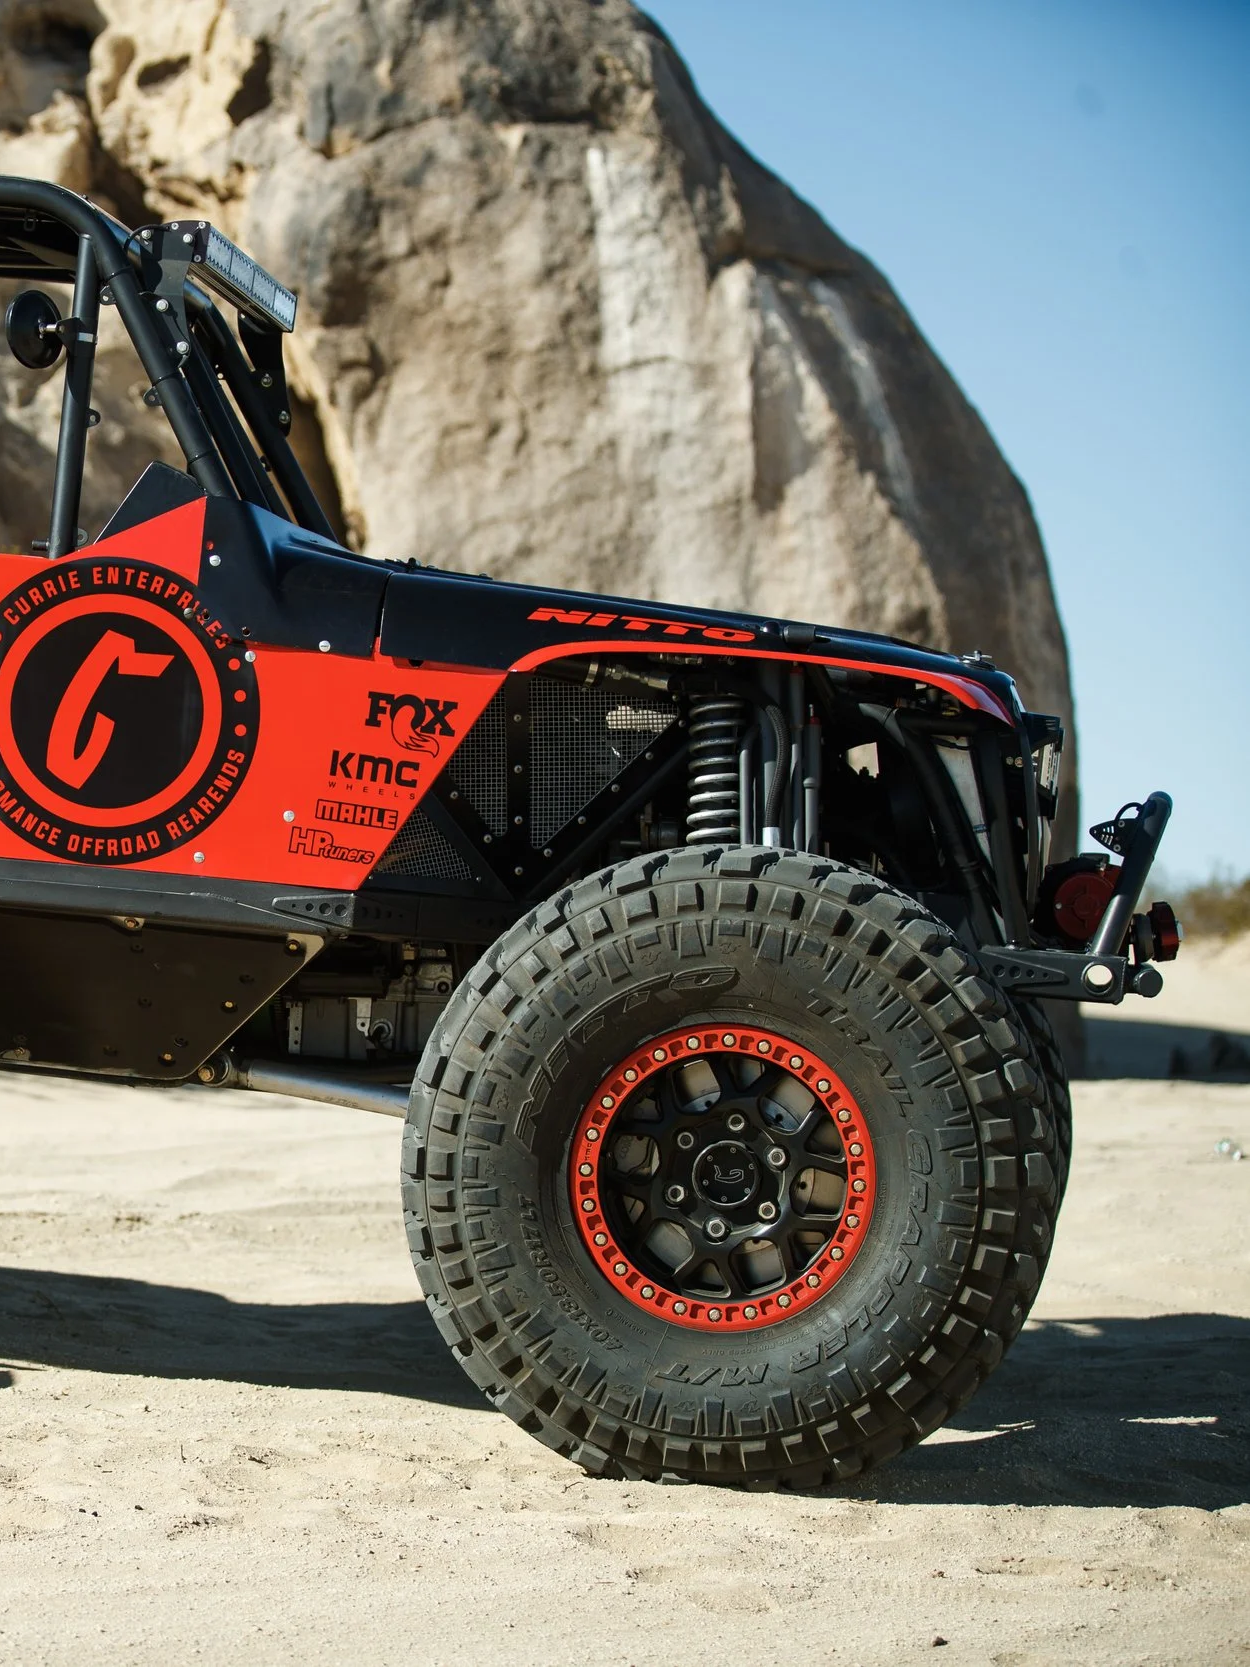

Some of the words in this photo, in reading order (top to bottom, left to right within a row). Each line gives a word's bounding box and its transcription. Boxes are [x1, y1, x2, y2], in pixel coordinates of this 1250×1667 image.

[3, 570, 81, 626] CURRIE
[527, 607, 756, 642] NITTO
[364, 691, 459, 740] FOX
[327, 780, 416, 800] WHEELS
[329, 750, 420, 788] KMC
[67, 829, 161, 857] OFFROAD
[167, 749, 246, 840] REARENDS
[315, 798, 398, 831] MAHLE
[513, 965, 740, 1152] NITTO
[805, 988, 916, 1119] TRAIL
